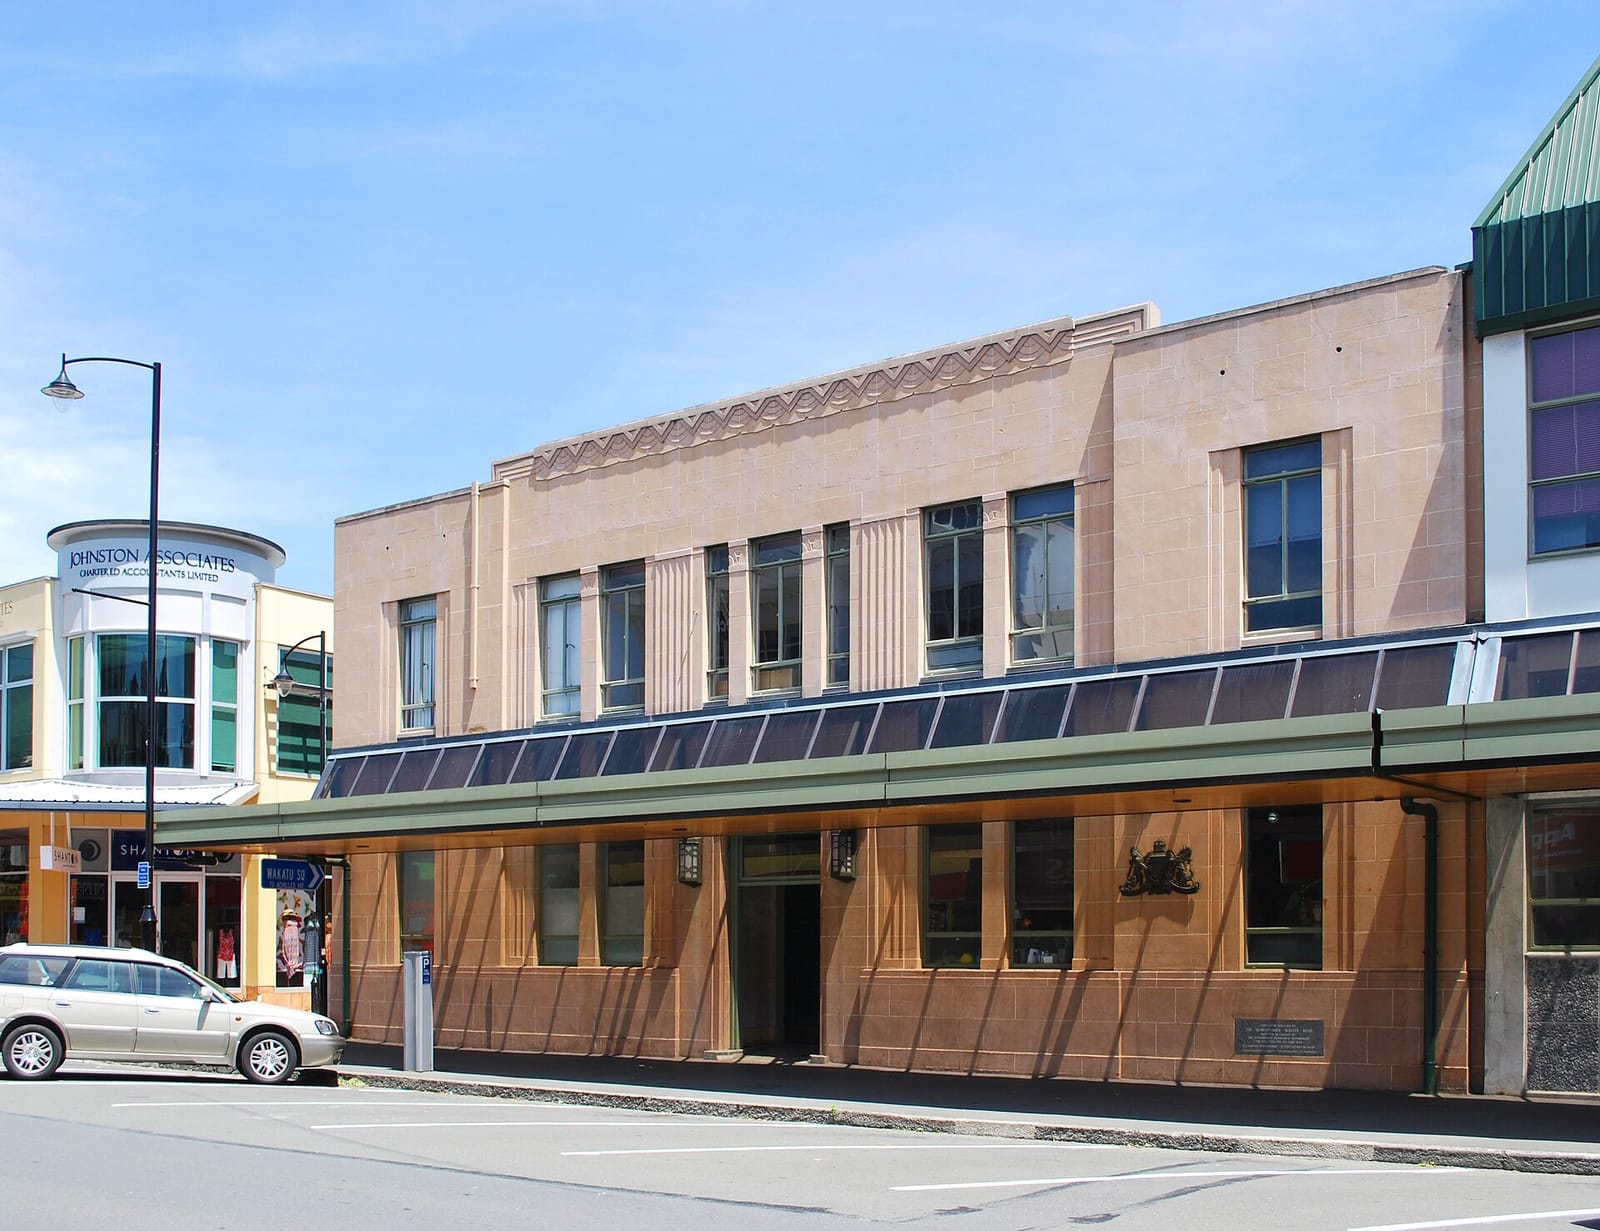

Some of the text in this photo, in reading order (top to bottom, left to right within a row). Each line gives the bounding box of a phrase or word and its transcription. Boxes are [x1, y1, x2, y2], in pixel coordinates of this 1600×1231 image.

[70, 548, 139, 569] JOHNSTON
[79, 567, 219, 582] CHARTERED ACCOTANTS LIMITED
[266, 867, 294, 881] WAKATU
[424, 958, 430, 969] P
